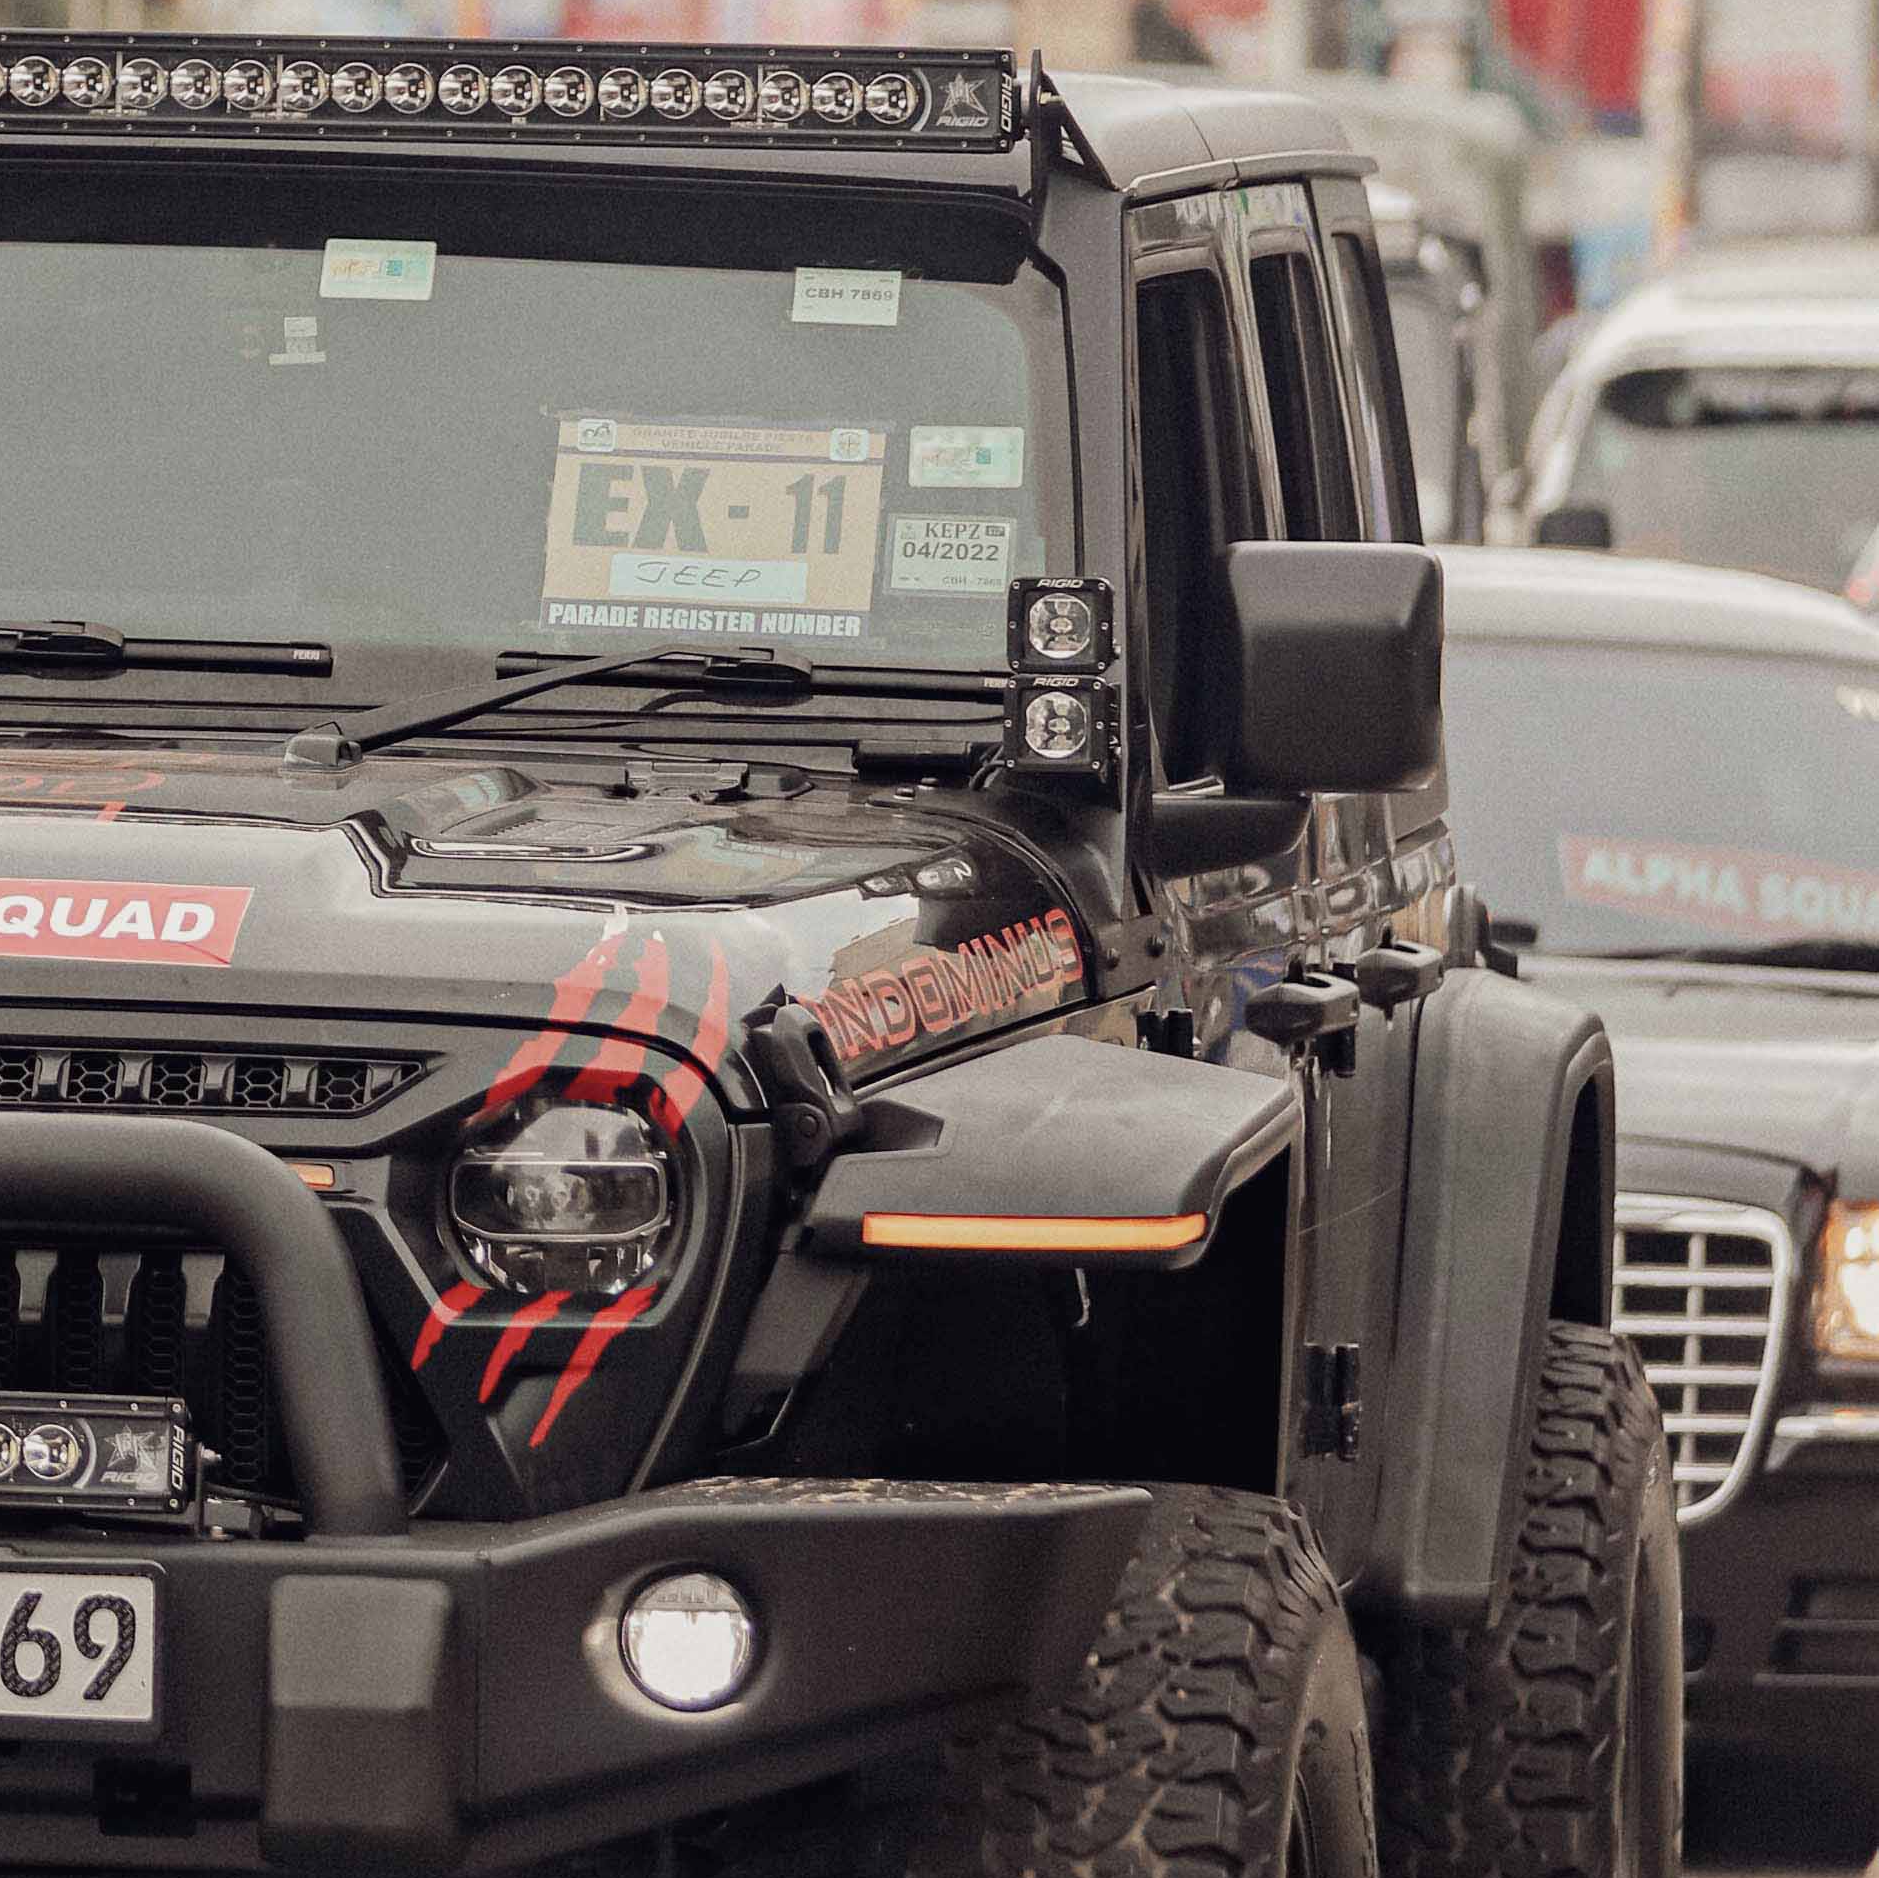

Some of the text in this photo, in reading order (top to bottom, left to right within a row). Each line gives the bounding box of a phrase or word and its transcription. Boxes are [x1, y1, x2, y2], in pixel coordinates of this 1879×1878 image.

[1001, 73, 1012, 133] RIGID
[935, 116, 989, 127] RIGID
[805, 287, 893, 300] CBH 7869
[573, 463, 711, 553] EX
[786, 473, 847, 555] 11
[924, 522, 980, 540] KEPZ
[902, 540, 1000, 561] 04/2022
[636, 560, 762, 588] JEEP
[1037, 579, 1085, 589] RIGID
[548, 602, 862, 637] PARADE REGISTER NUMBER
[1033, 677, 1080, 688] RIGID
[1583, 847, 1749, 915] ALPHA
[796, 907, 1083, 1061] INDOMINUS
[172, 1425, 185, 1491] RIGID
[100, 1471, 160, 1483] RIGID
